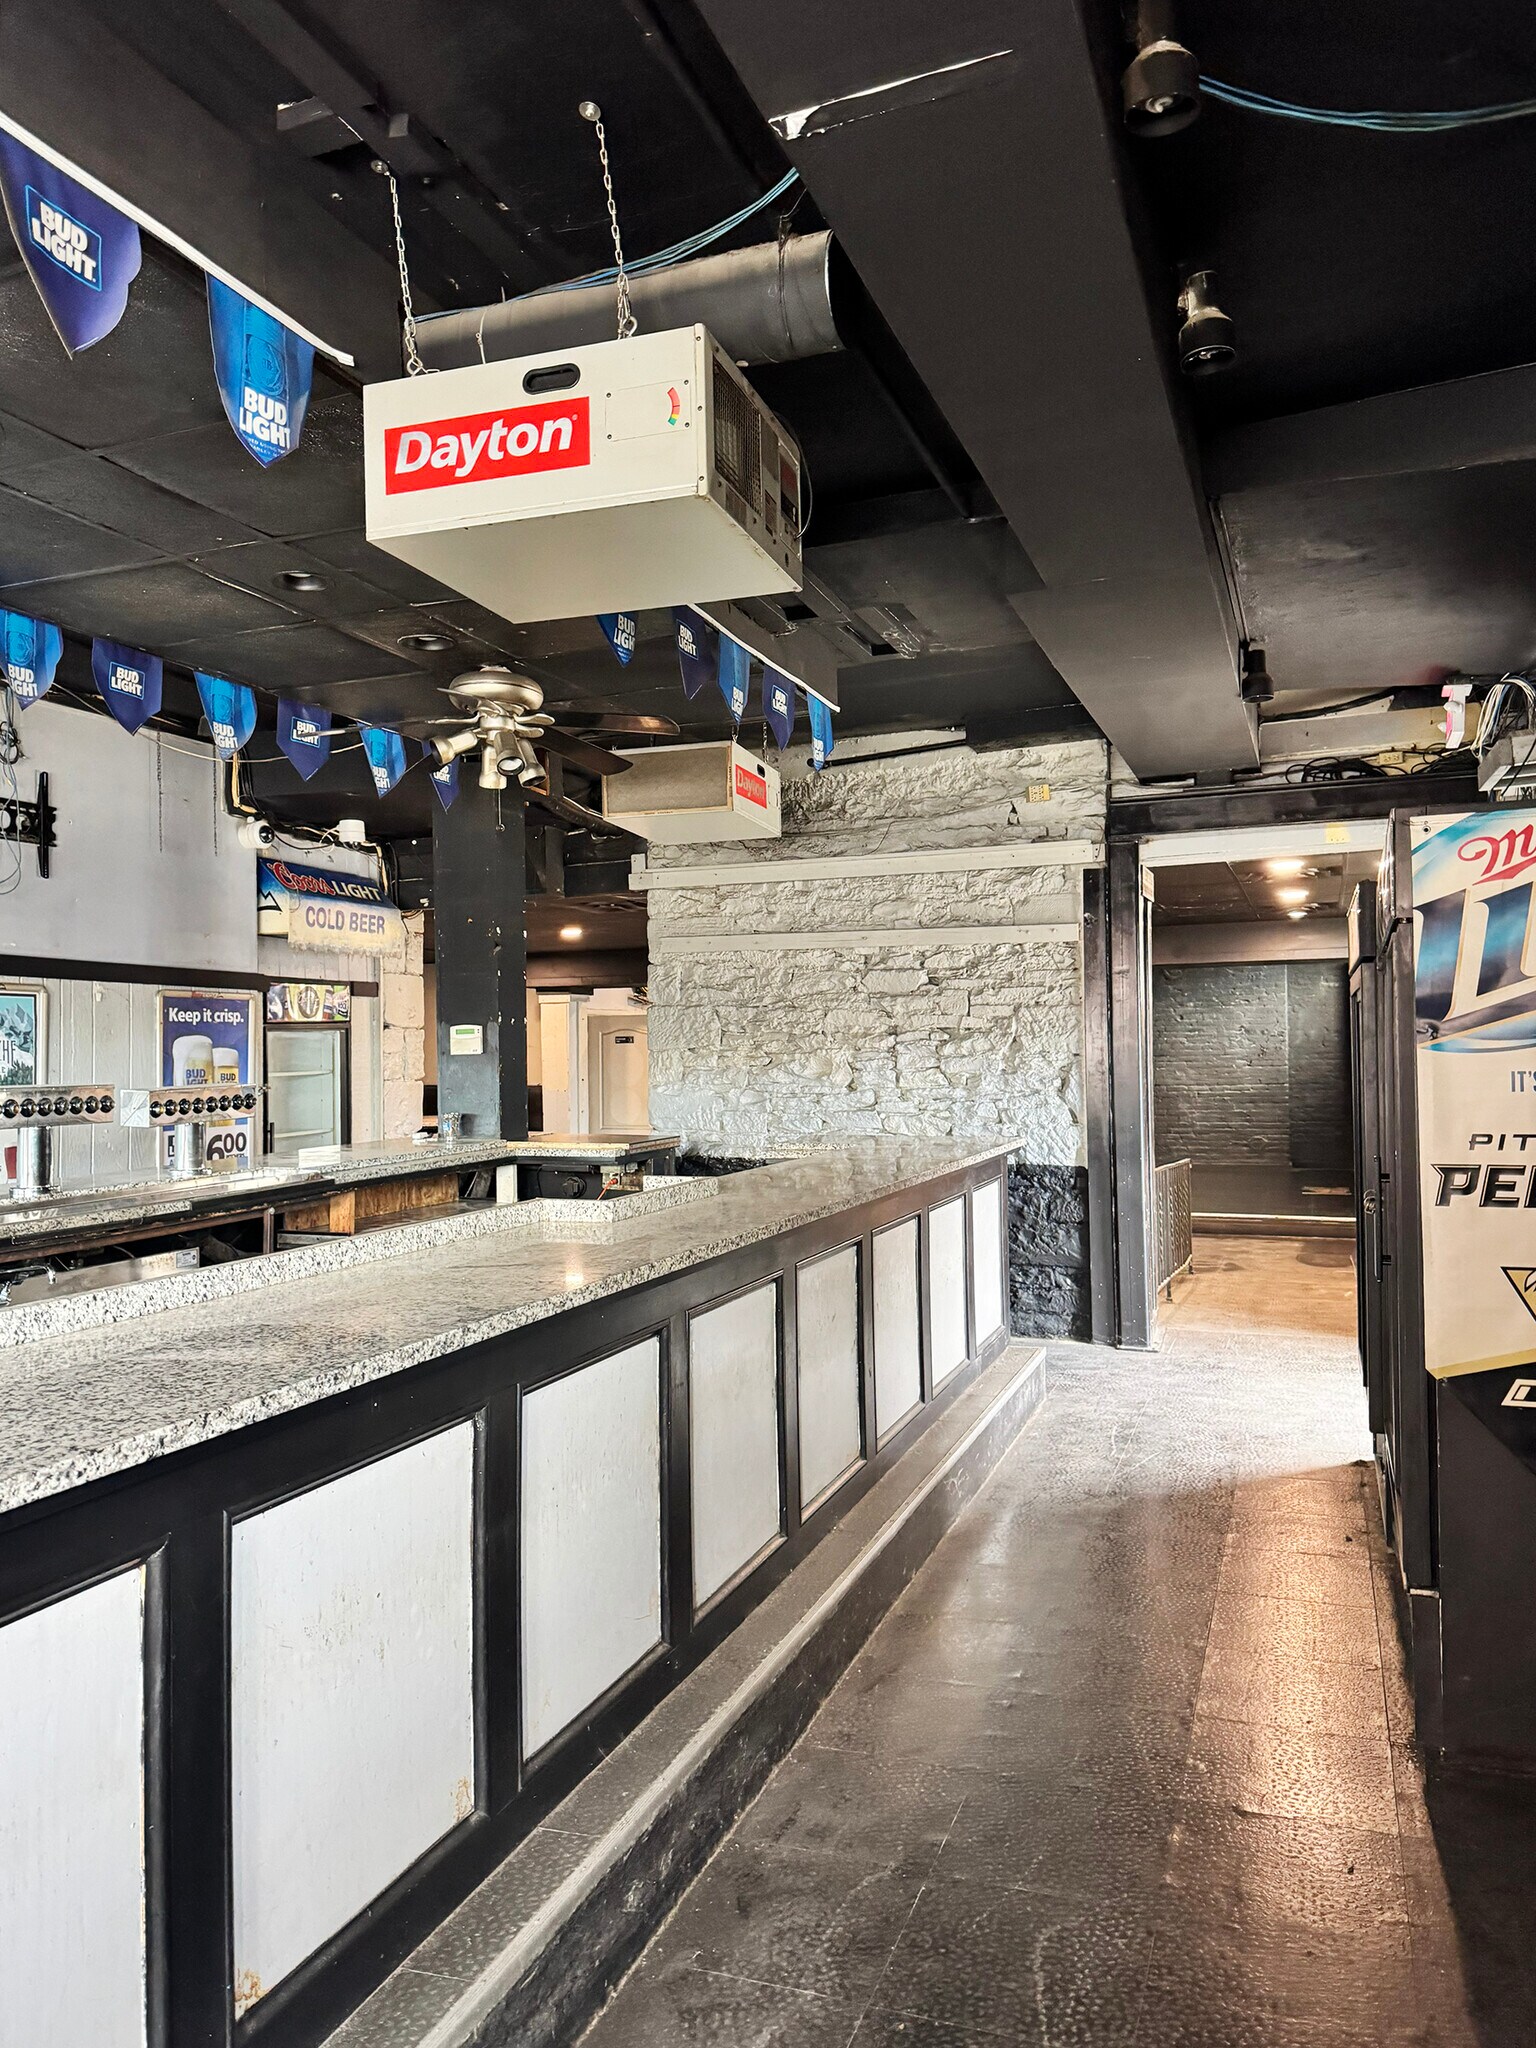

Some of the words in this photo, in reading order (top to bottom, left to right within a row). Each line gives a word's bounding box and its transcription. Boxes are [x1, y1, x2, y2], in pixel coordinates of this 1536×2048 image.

[40, 201, 88, 252] BUD
[244, 386, 287, 426] BUD
[239, 406, 291, 450] LIGHT
[394, 418, 574, 478] Dayton
[617, 614, 636, 636] BUD
[679, 624, 694, 643] BUD
[613, 627, 636, 652] LIGH
[677, 635, 697, 656] LIGHT
[7, 663, 35, 683] BUD
[116, 666, 140, 684] BUD
[111, 676, 143, 697] LIGHT
[212, 721, 235, 737] BUD
[296, 720, 317, 733] BUD
[266, 861, 336, 896] Coors
[331, 880, 382, 901] LIGHT
[305, 905, 345, 931] COLD
[349, 911, 386, 935] BEER
[168, 1007, 201, 1026] Keep
[203, 1008, 212, 1023] it
[213, 1008, 245, 1026] crisp.
[185, 1068, 206, 1079] BUD
[220, 1072, 236, 1081] BUD
